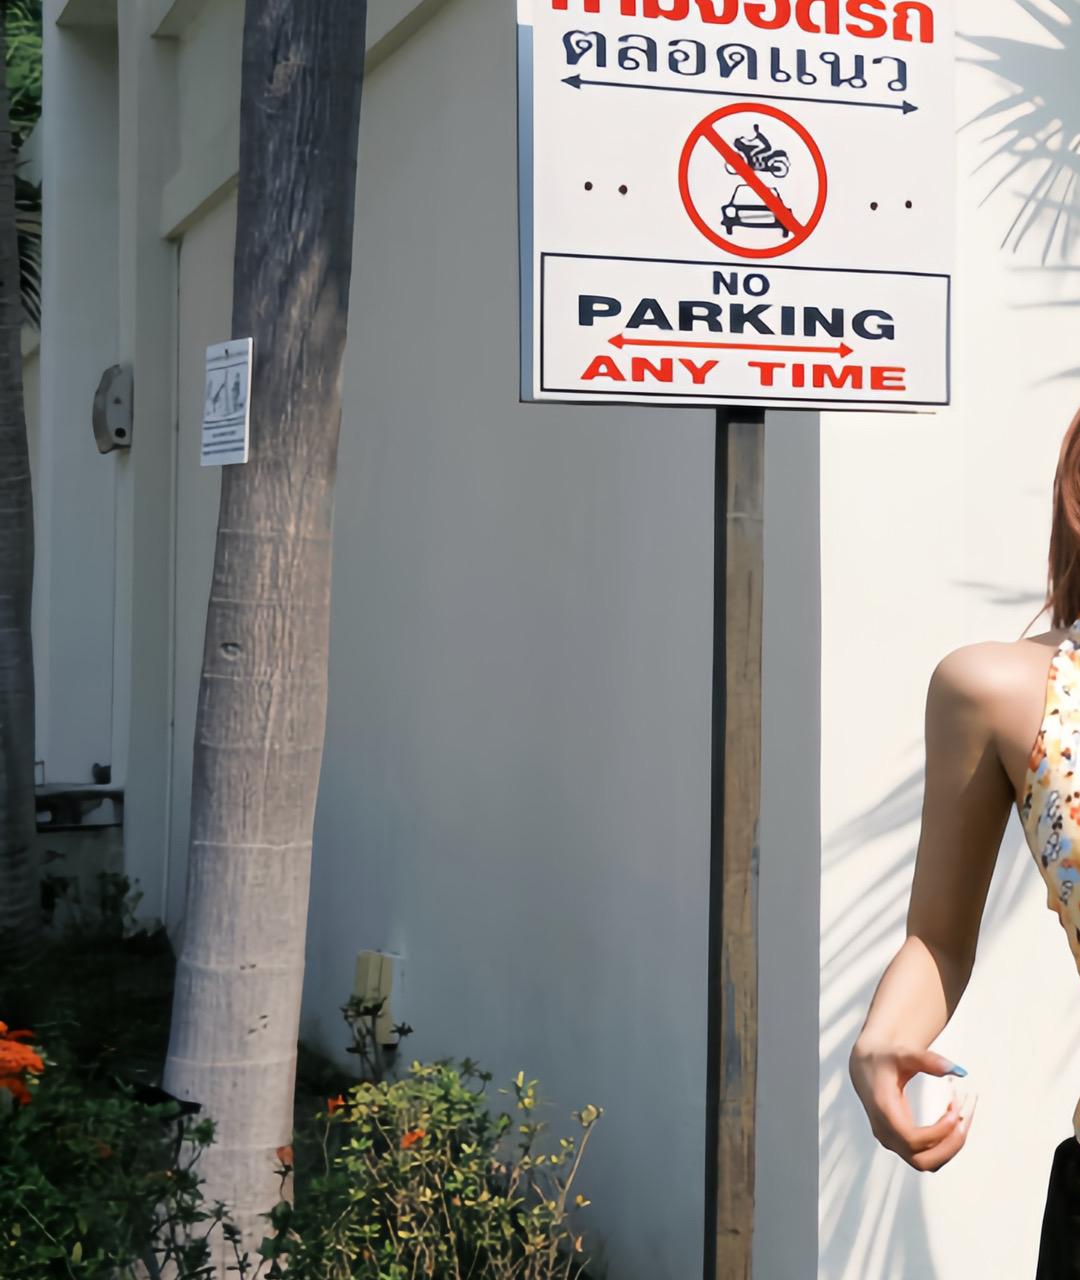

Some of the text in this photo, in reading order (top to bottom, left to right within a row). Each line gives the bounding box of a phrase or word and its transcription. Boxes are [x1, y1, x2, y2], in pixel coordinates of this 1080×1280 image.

[561, 28, 908, 93] ตลอดแนว
[711, 269, 772, 298] NO
[577, 293, 896, 342] PARKING
[579, 353, 908, 393] ANY TIME
